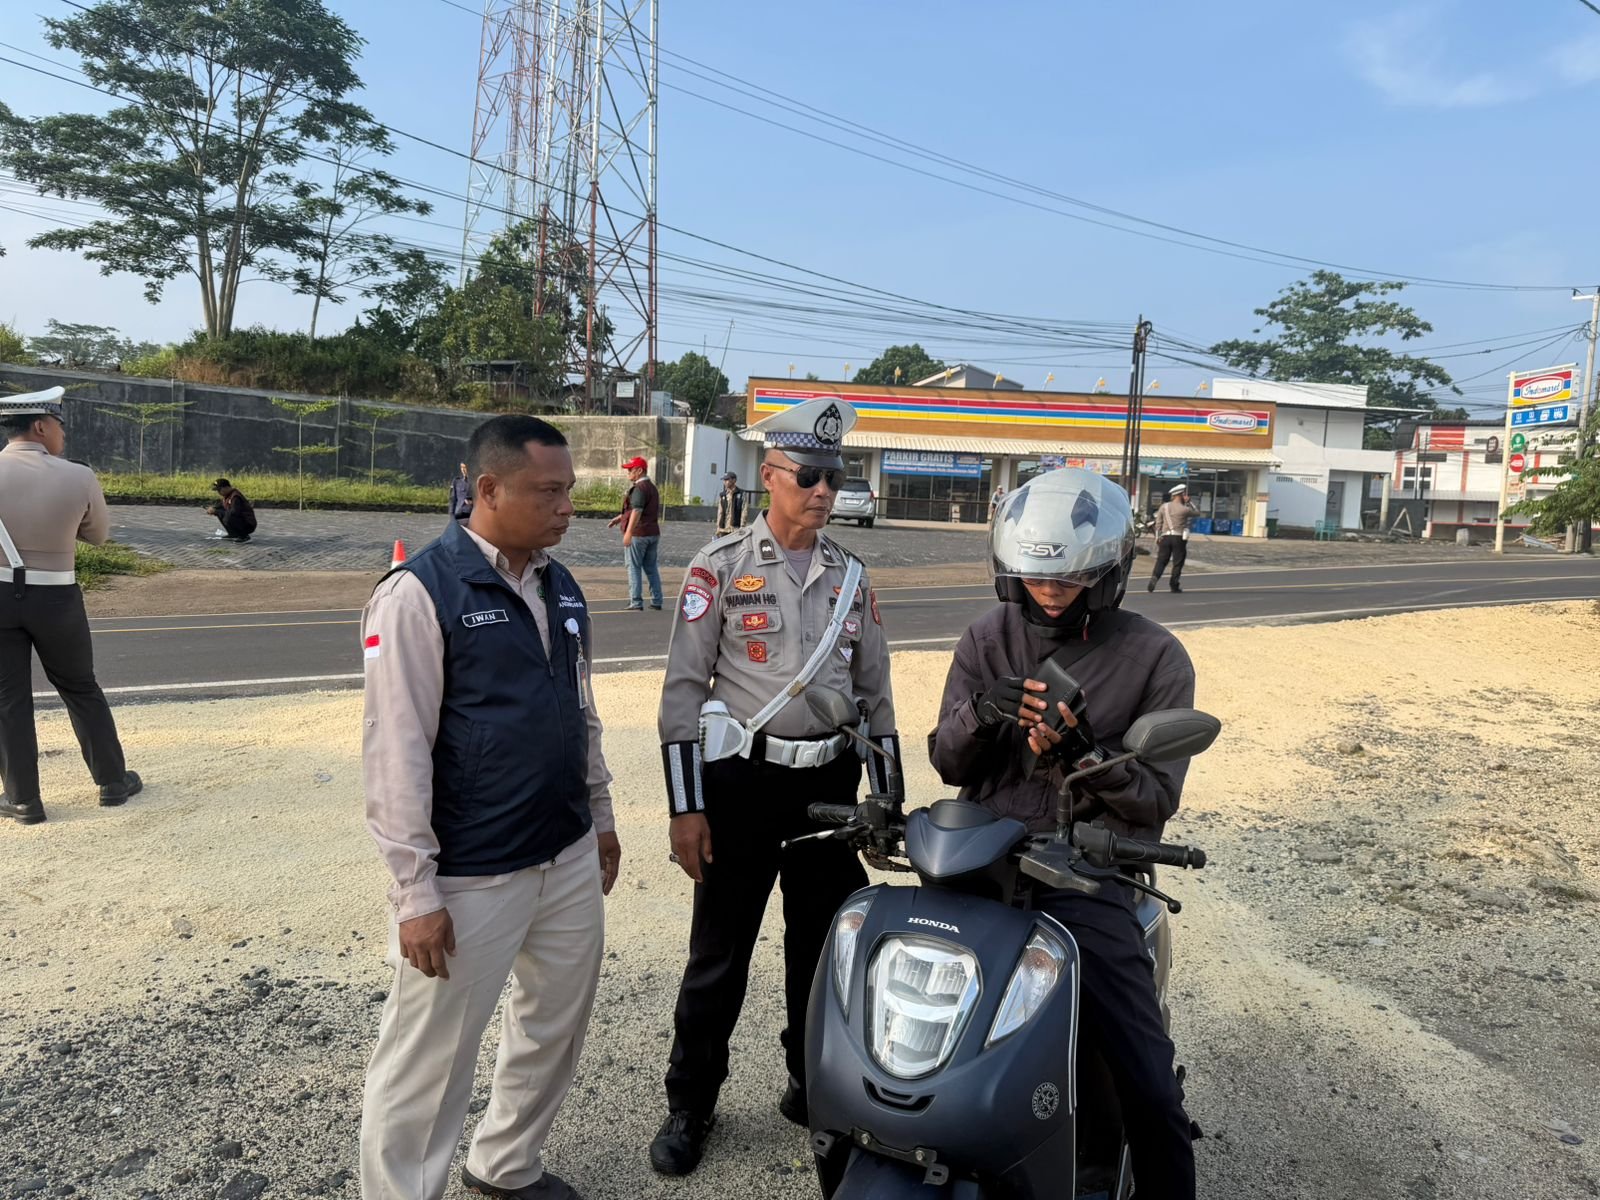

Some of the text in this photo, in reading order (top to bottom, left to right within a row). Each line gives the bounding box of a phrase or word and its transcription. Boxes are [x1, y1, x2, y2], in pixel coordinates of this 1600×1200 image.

[1524, 383, 1560, 396] Indomaret
[1212, 416, 1252, 426] Indomaret
[884, 450, 918, 461] PARKIR
[920, 452, 954, 463] GRATIS
[1019, 542, 1066, 558] RSV
[725, 594, 761, 608] WAWAN
[472, 613, 496, 624] IWAN
[907, 917, 960, 934] HONDA
